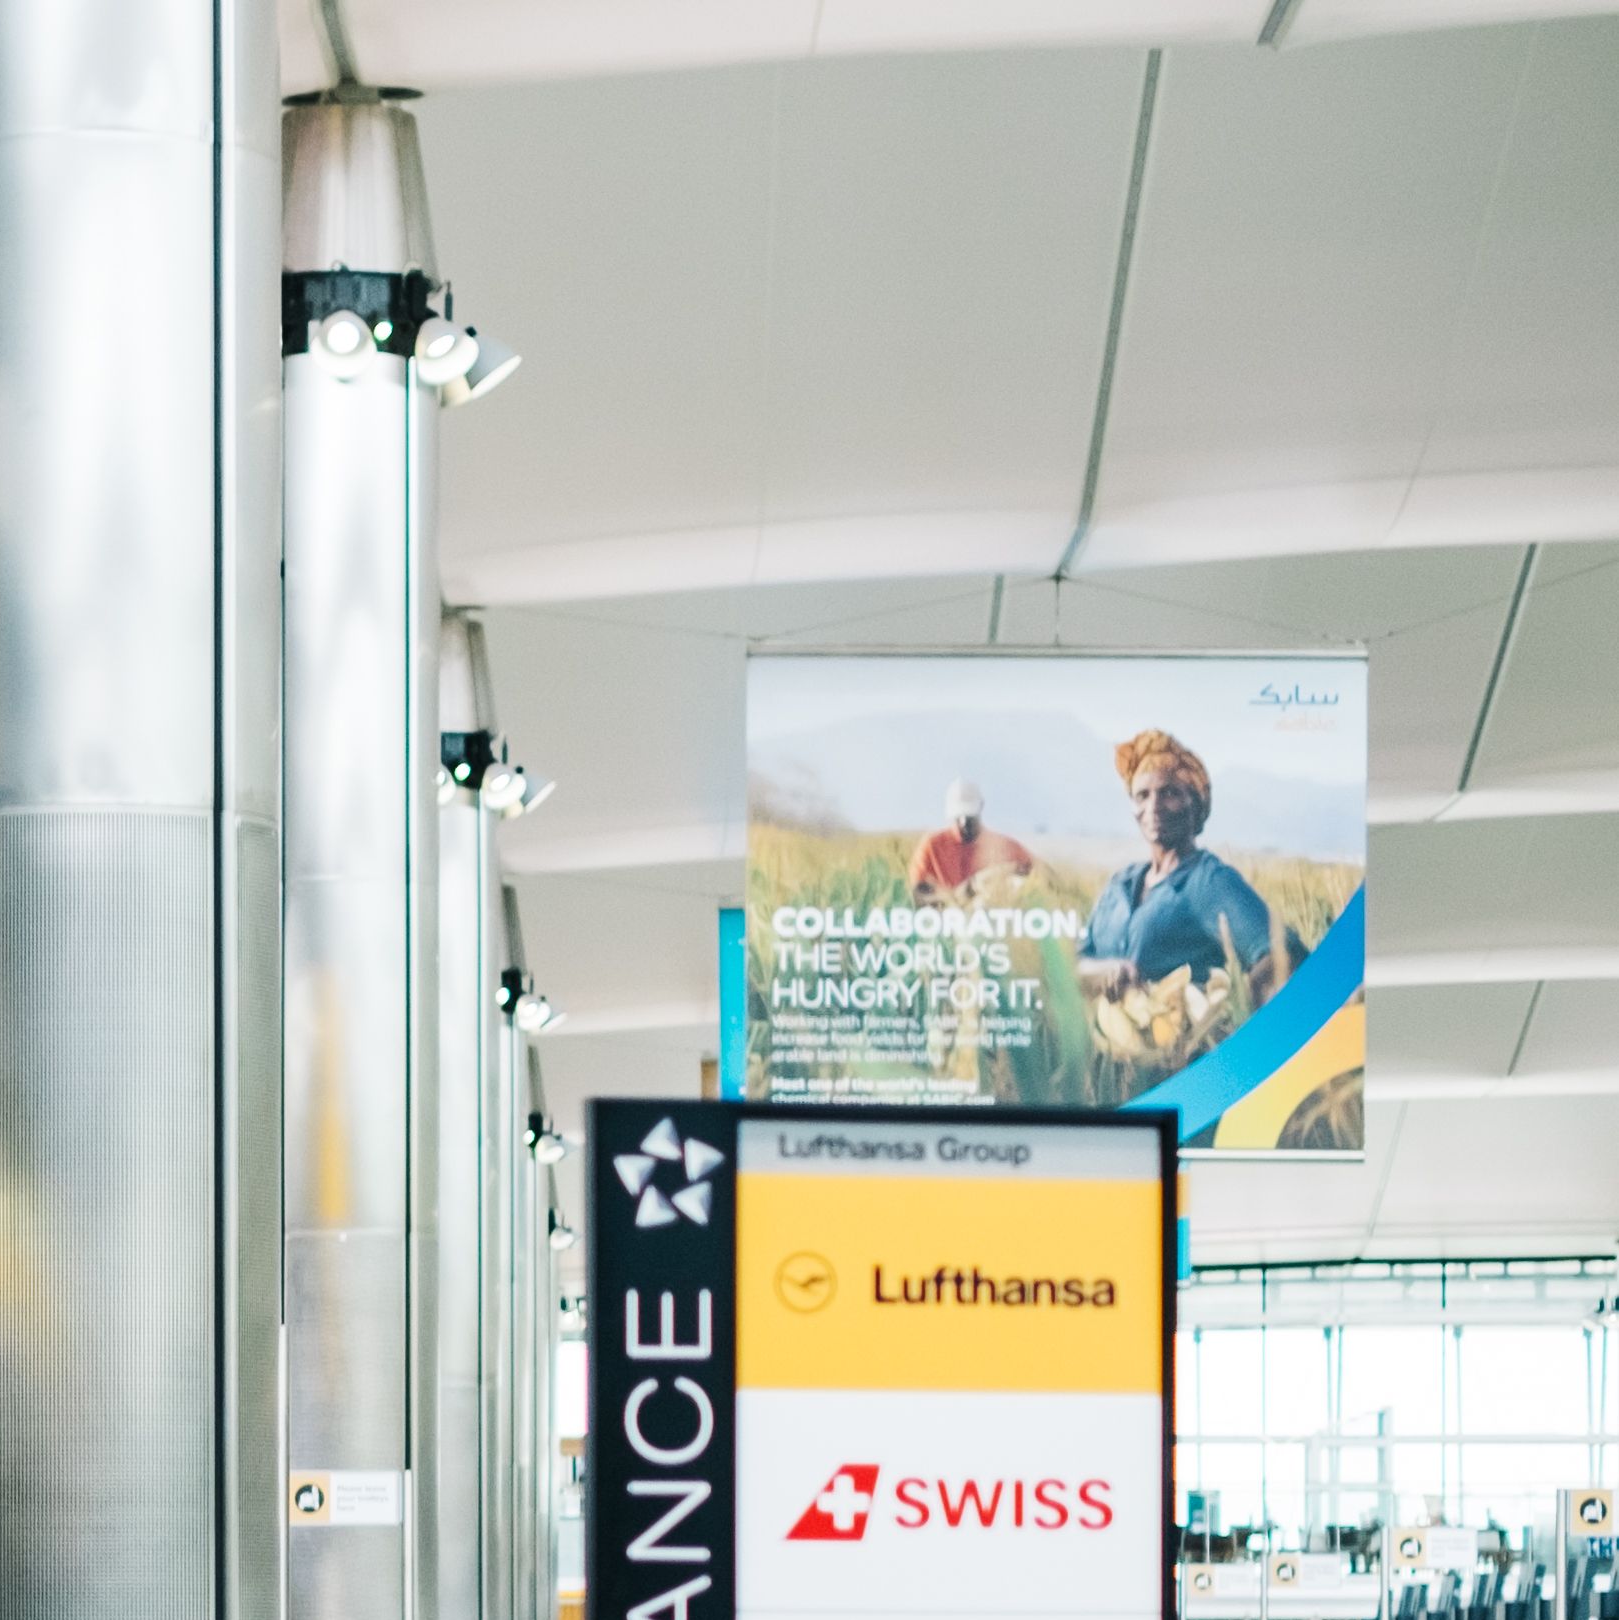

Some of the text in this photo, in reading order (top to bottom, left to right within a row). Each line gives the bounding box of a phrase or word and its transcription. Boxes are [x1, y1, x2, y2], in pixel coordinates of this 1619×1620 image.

[772, 907, 1088, 939] COLLABORATION.
[773, 943, 1011, 976] THE WORLD'S
[772, 978, 1044, 1010] HUNGRY FOR IT.
[772, 1014, 828, 1031] Working
[830, 1014, 861, 1030] with
[981, 1014, 1031, 1033] helping
[777, 1134, 1032, 1167] Lufthansa Group
[874, 1265, 1117, 1309] Lufthansa
[894, 1478, 1114, 1531] SWISS
